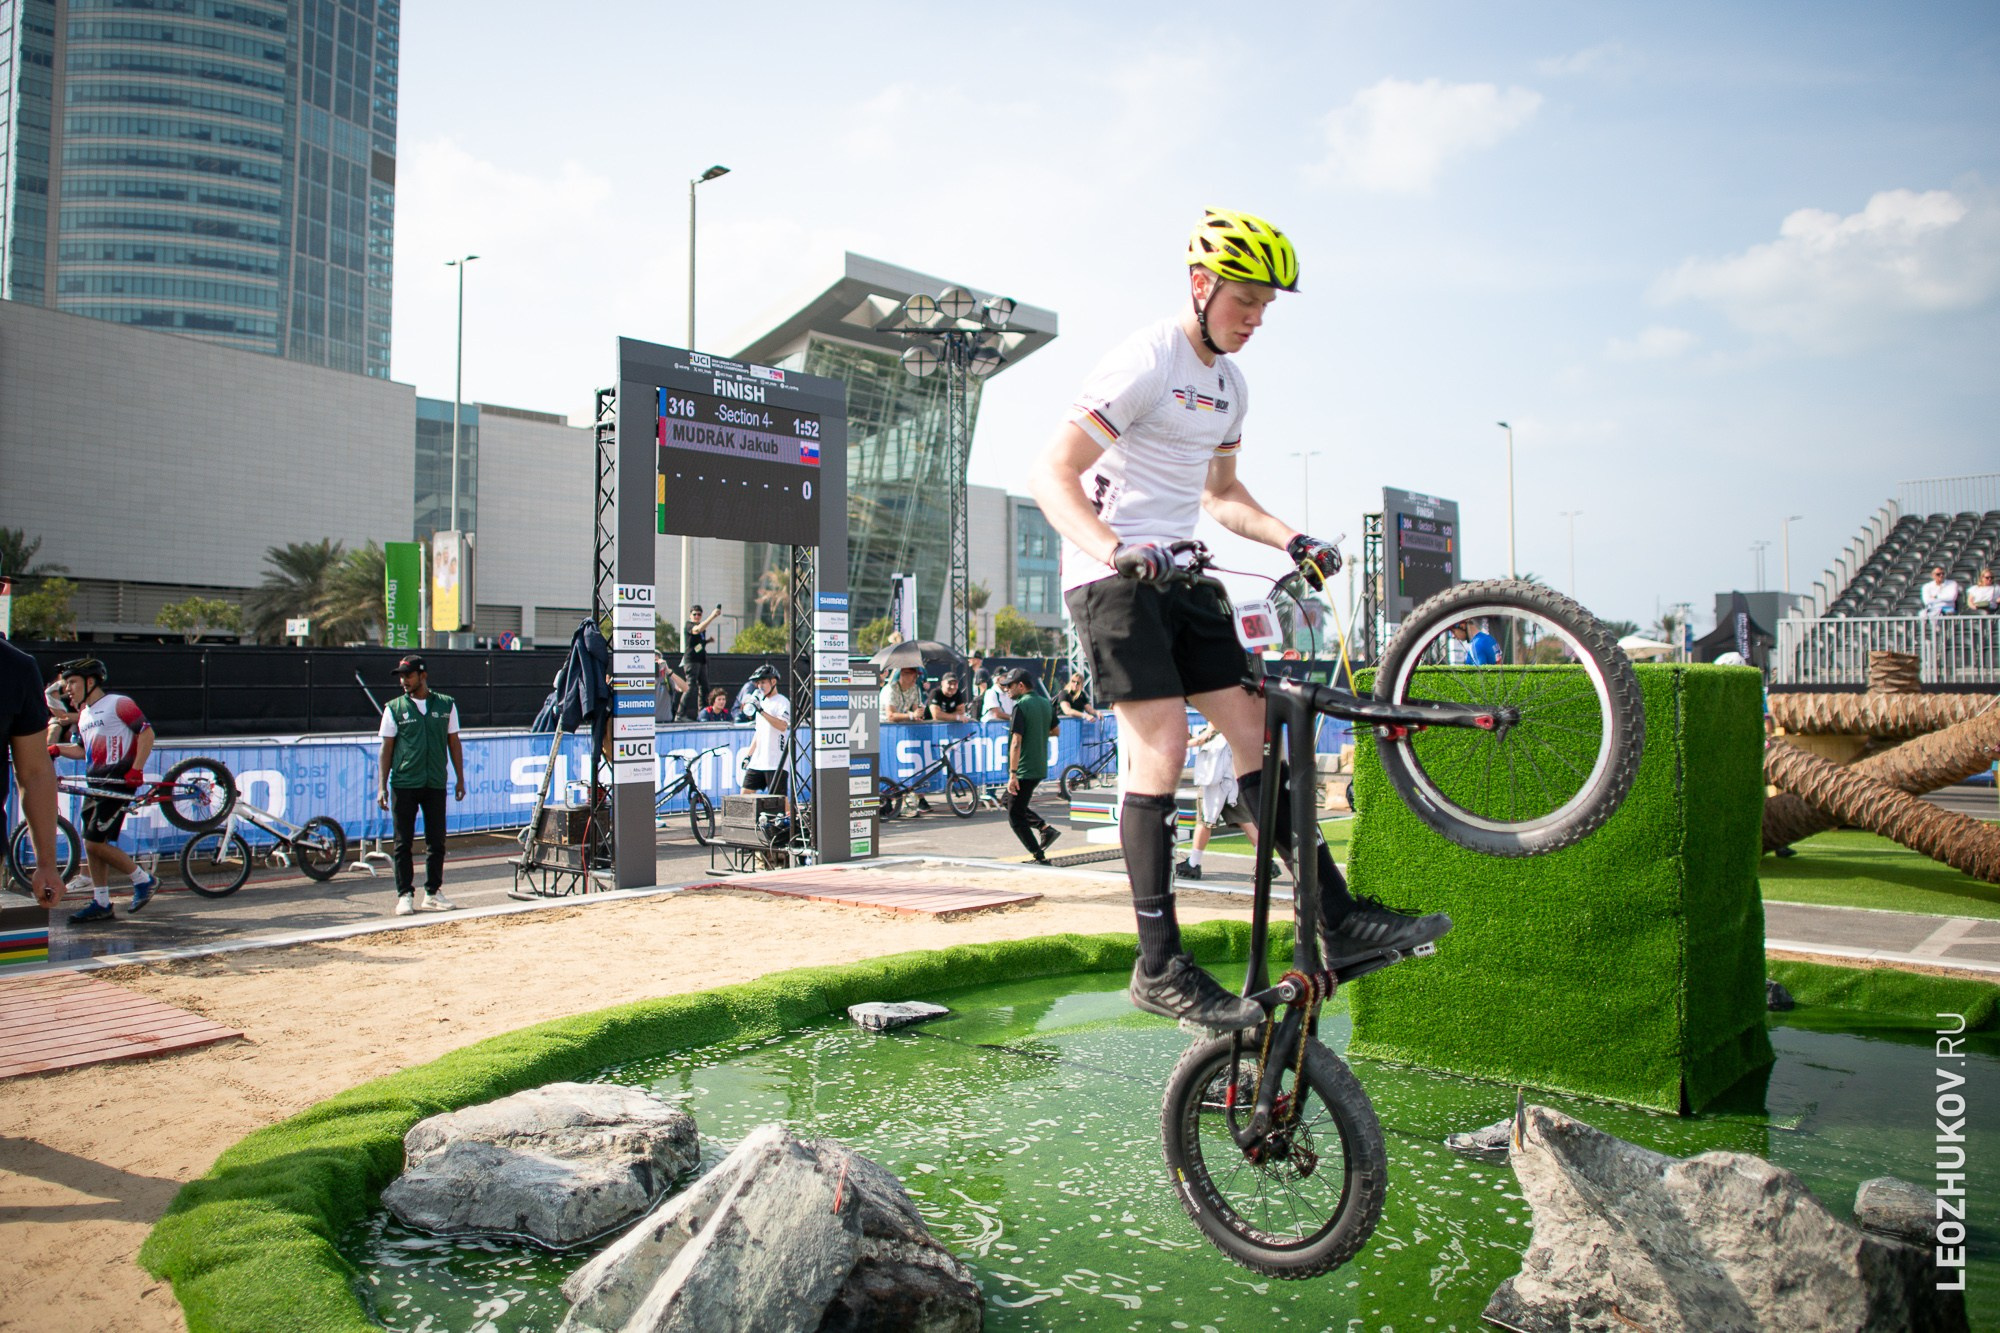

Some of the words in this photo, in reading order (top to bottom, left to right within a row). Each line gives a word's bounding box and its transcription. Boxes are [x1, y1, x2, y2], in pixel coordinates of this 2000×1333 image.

[694, 356, 708, 366] UCI
[713, 378, 765, 402] FINISH
[668, 397, 695, 417] 316
[793, 418, 819, 437] 1:52
[673, 425, 735, 449] MUDRÁK
[740, 436, 778, 454] Jakub
[802, 481, 812, 500] 0
[388, 580, 397, 619] DHABI
[625, 588, 651, 601] UCI
[820, 597, 848, 605] SHIMANO
[820, 694, 848, 702] SHIMANO
[849, 695, 878, 709] NISH
[826, 733, 846, 744] UCI
[849, 713, 868, 750] 4
[626, 743, 651, 756] UCI
